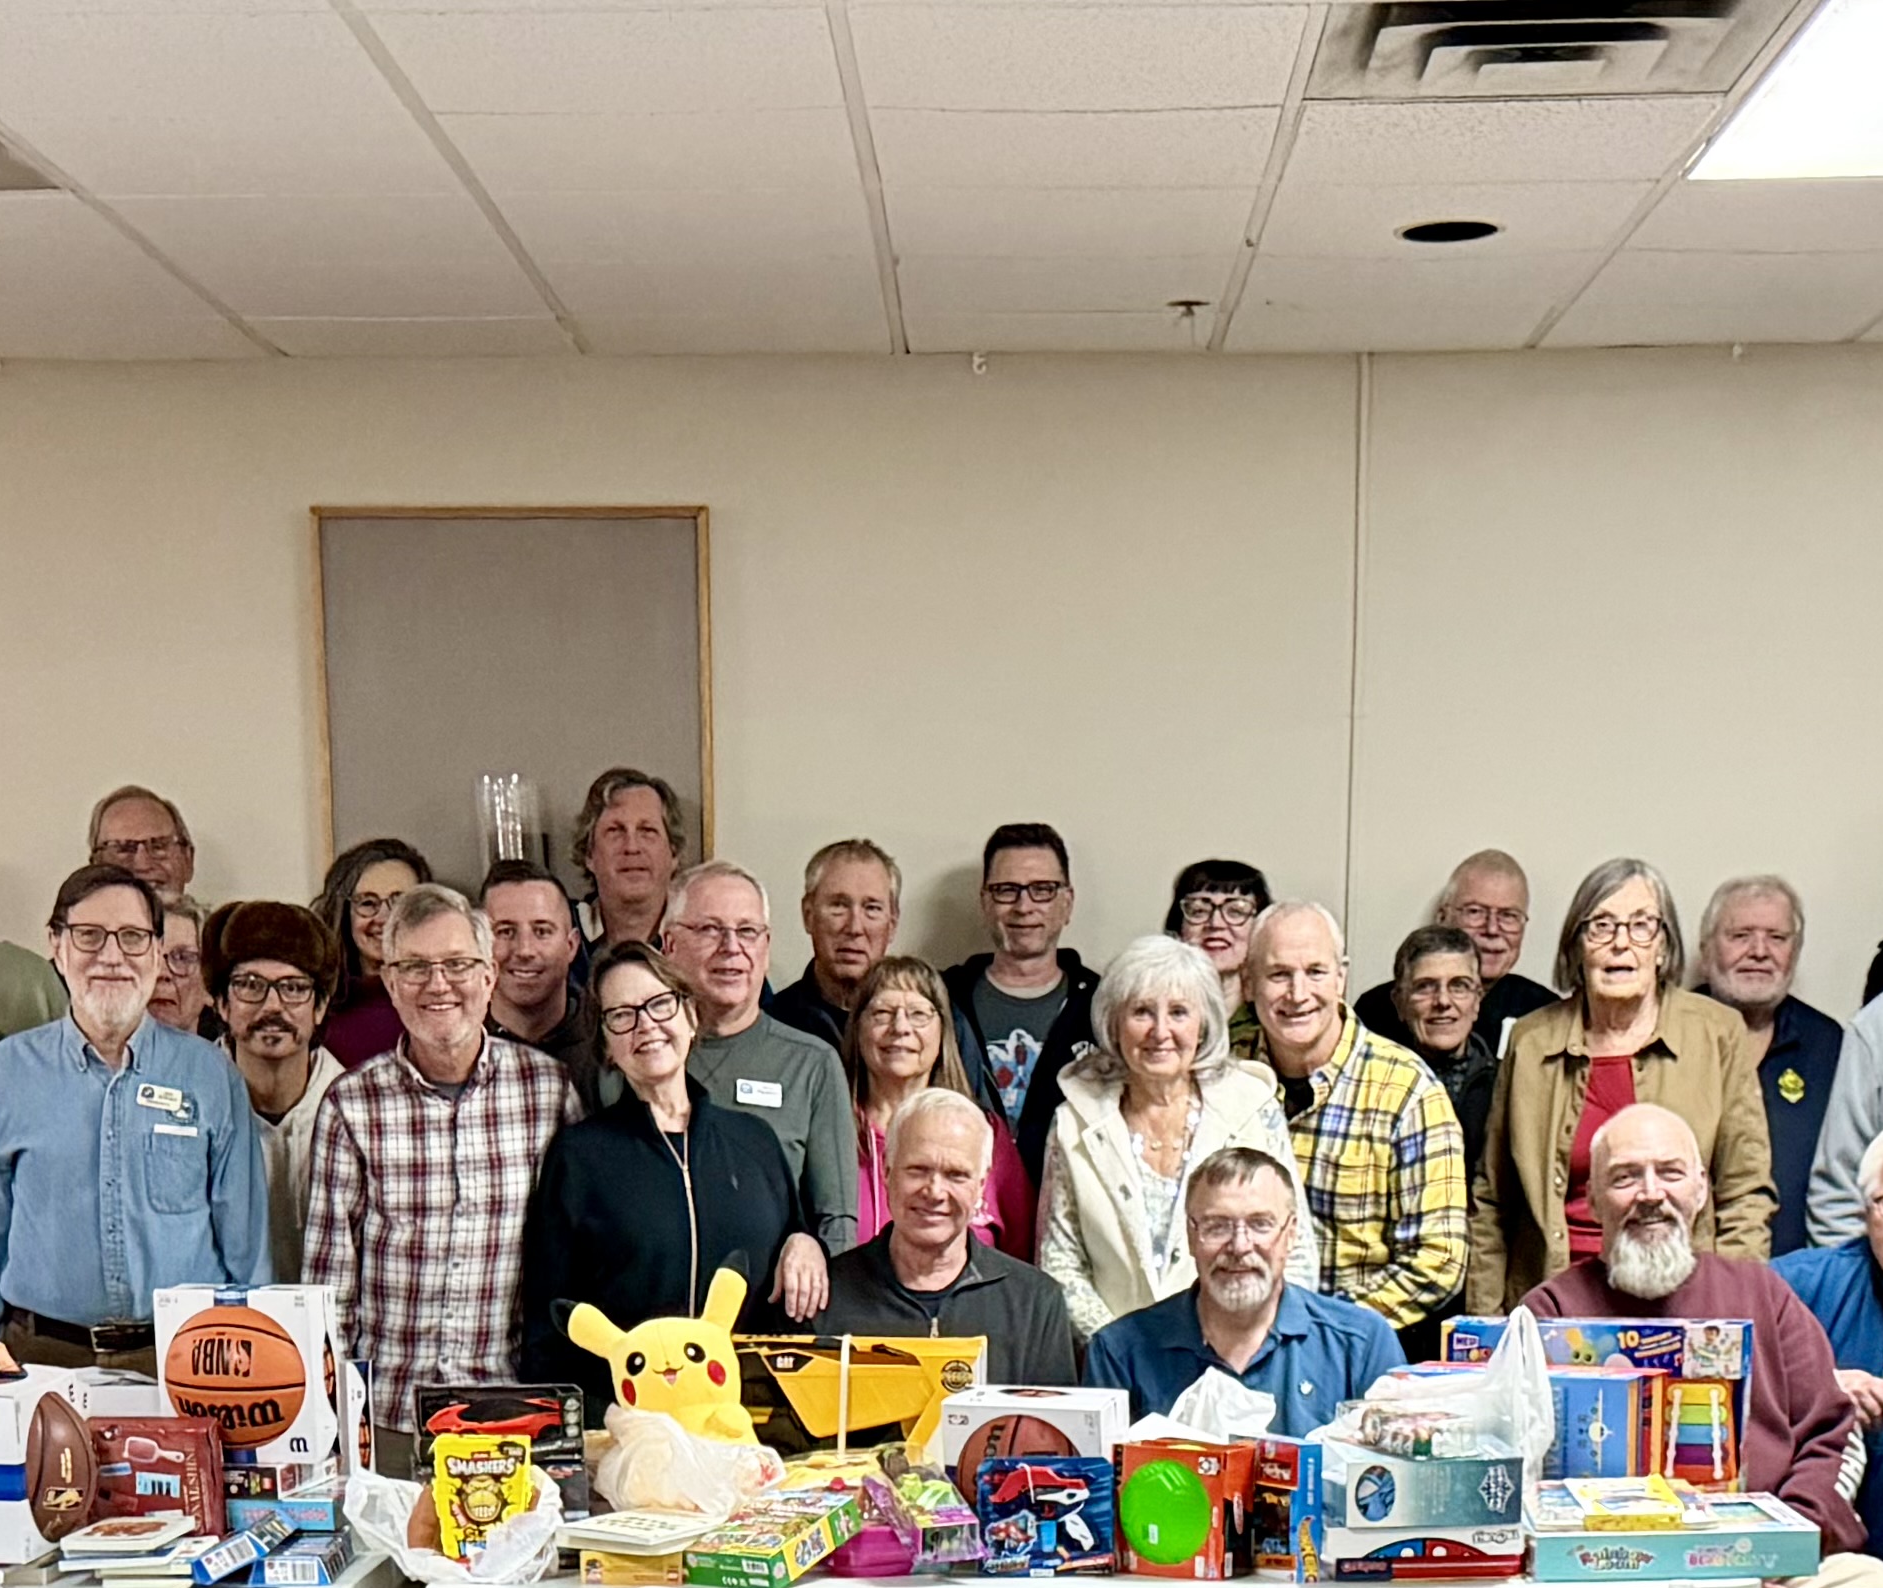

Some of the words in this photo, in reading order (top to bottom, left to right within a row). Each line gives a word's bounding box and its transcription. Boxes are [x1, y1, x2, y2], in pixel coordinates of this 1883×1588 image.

[1617, 1332, 1640, 1349] 10
[191, 1337, 233, 1376] NBA
[776, 1355, 795, 1369] CAT
[175, 1396, 285, 1430] Wilson
[446, 1457, 516, 1476] SMASHERS
